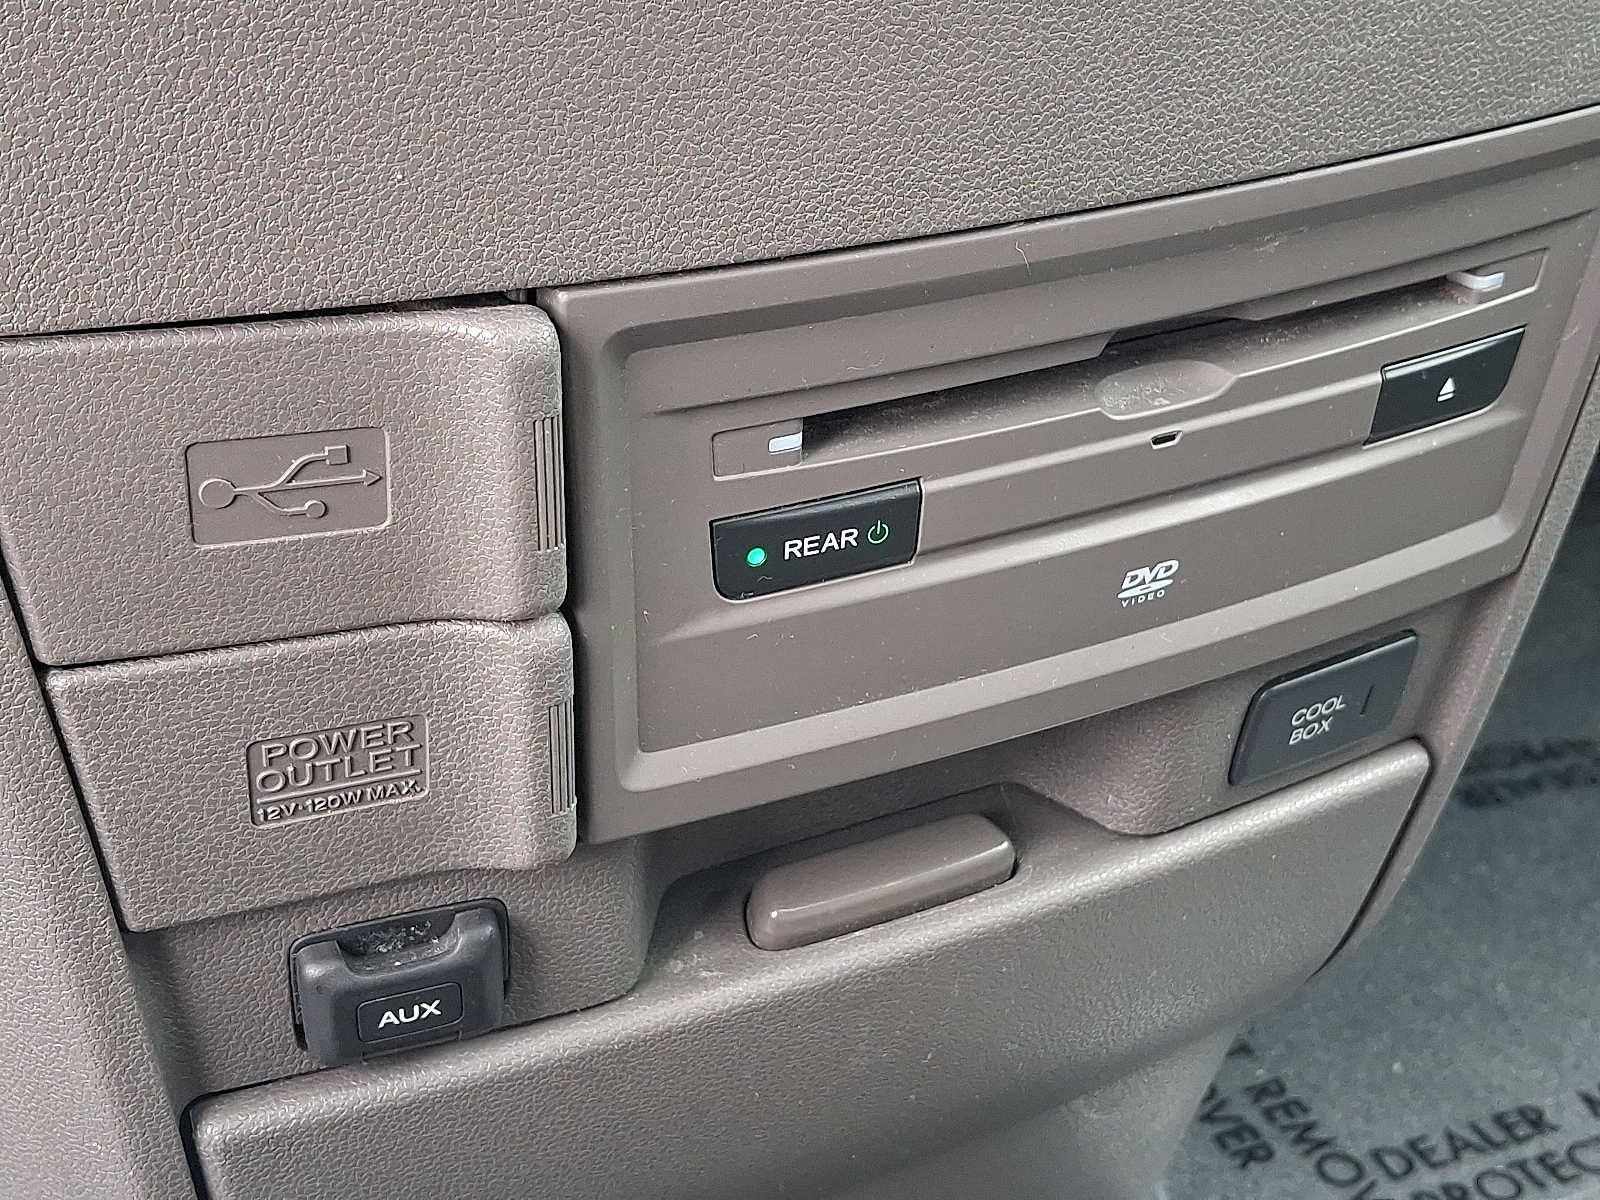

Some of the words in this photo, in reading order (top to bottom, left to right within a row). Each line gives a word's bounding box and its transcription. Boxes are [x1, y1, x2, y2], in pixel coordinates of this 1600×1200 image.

[784, 528, 859, 560] REAR
[1121, 559, 1180, 590] DVD
[1121, 589, 1165, 608] VIDEO
[1291, 695, 1347, 726] COOL
[261, 721, 415, 768] POWER
[1288, 716, 1333, 745] BOX
[256, 743, 422, 793] OUTLET
[377, 999, 442, 1030] AUX
[1368, 1103, 1560, 1180] DEALER
